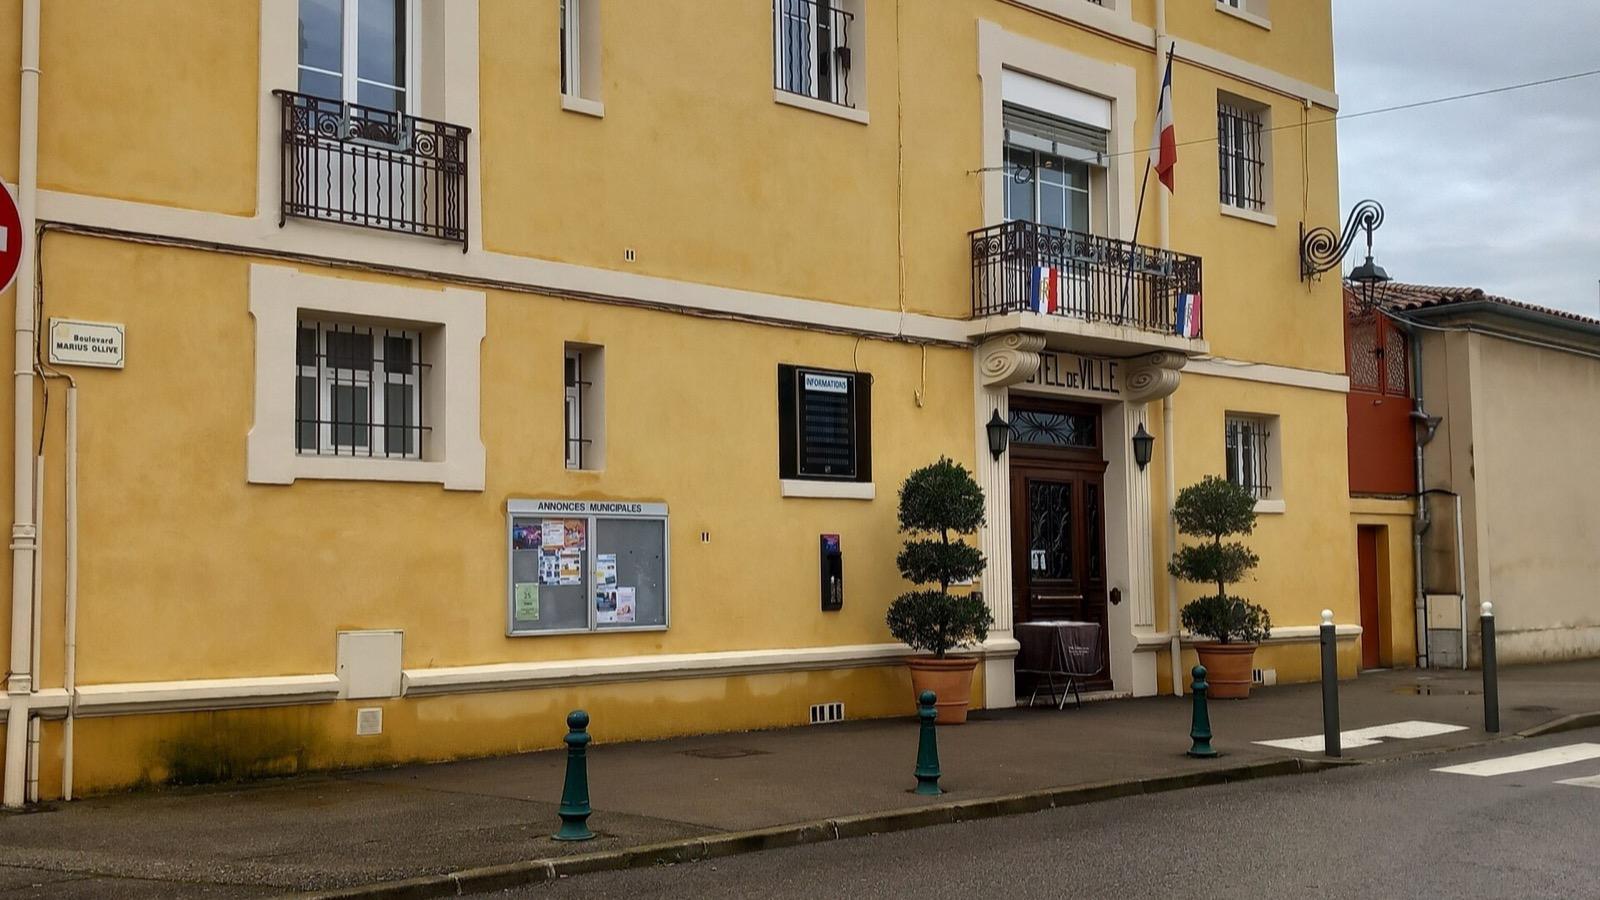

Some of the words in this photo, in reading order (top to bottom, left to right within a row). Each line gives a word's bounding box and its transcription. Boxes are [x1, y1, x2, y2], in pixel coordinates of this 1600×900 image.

[73, 334, 114, 344] Boulevard
[56, 342, 88, 351] MARIUS
[92, 344, 118, 354] OLLIVE
[1079, 357, 1120, 394] VILLE
[806, 378, 846, 389] INFORMATIONS
[537, 502, 586, 512] ANNONCES
[589, 503, 642, 513] MUNICIPALES
